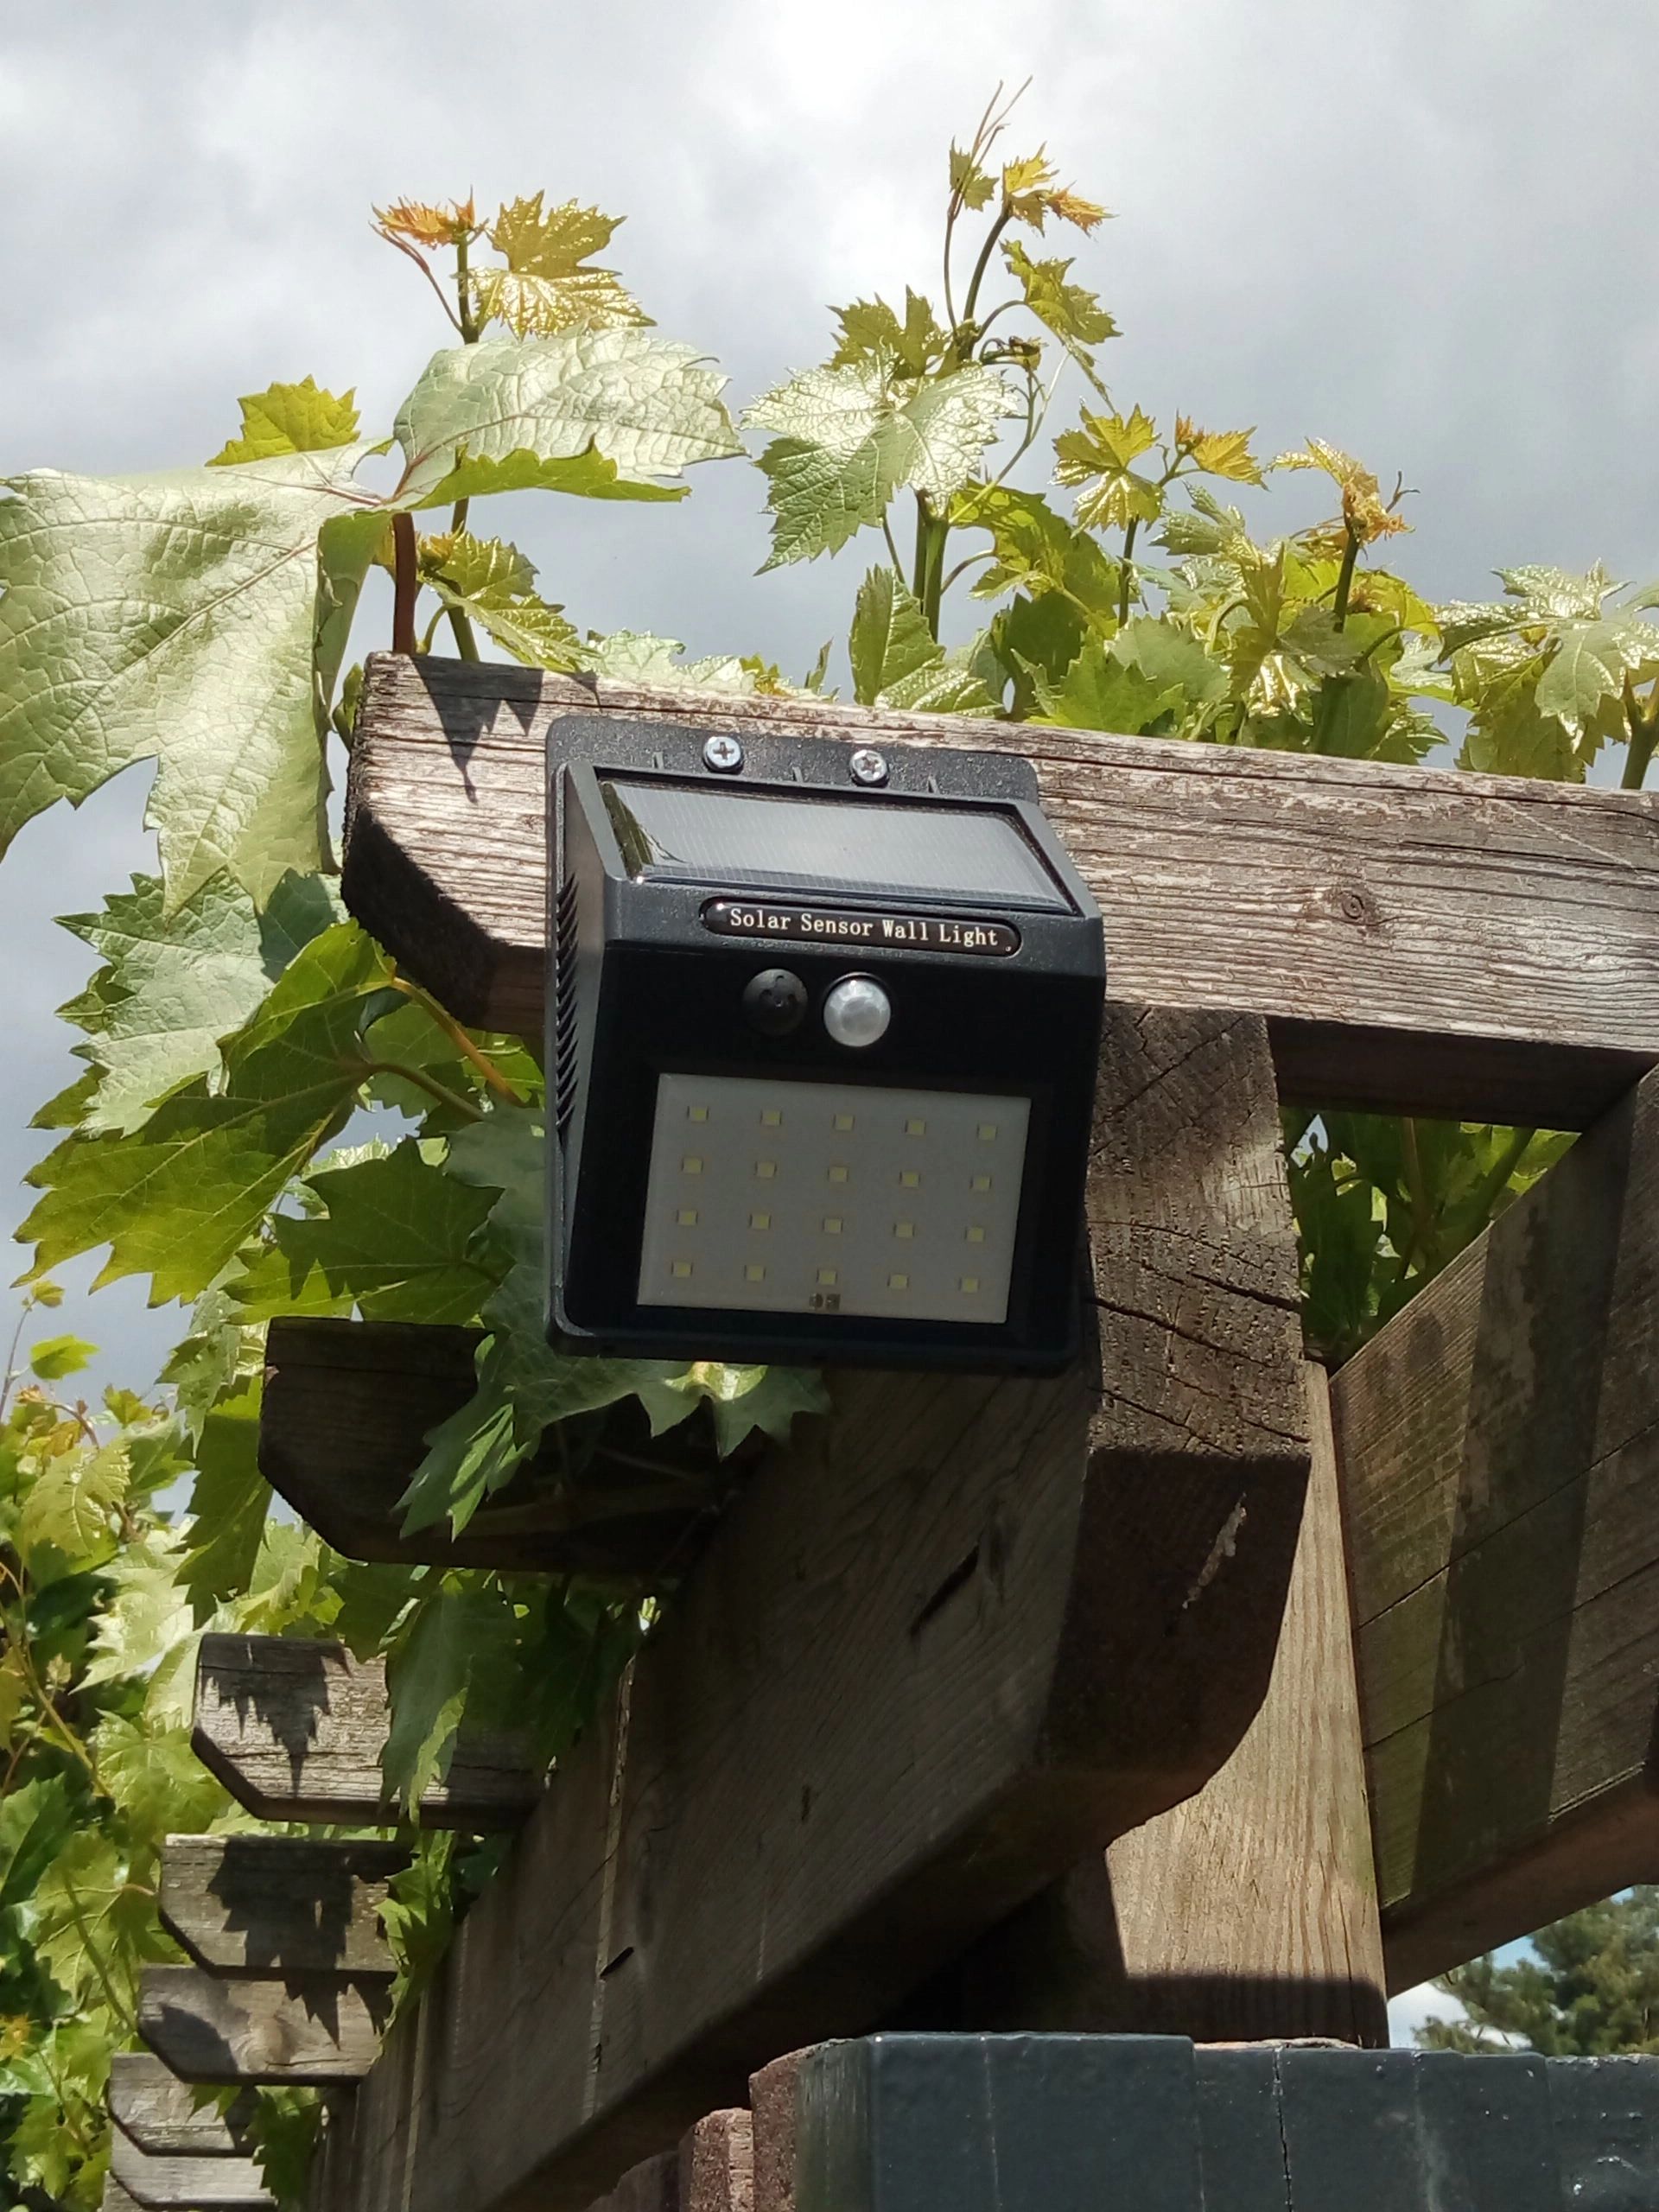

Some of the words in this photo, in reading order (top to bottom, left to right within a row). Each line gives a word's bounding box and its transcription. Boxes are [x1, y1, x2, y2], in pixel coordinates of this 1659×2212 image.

[730, 908, 791, 931] Solar
[800, 913, 873, 936] Sensor
[881, 919, 929, 941] Wall
[939, 924, 998, 948] Light
